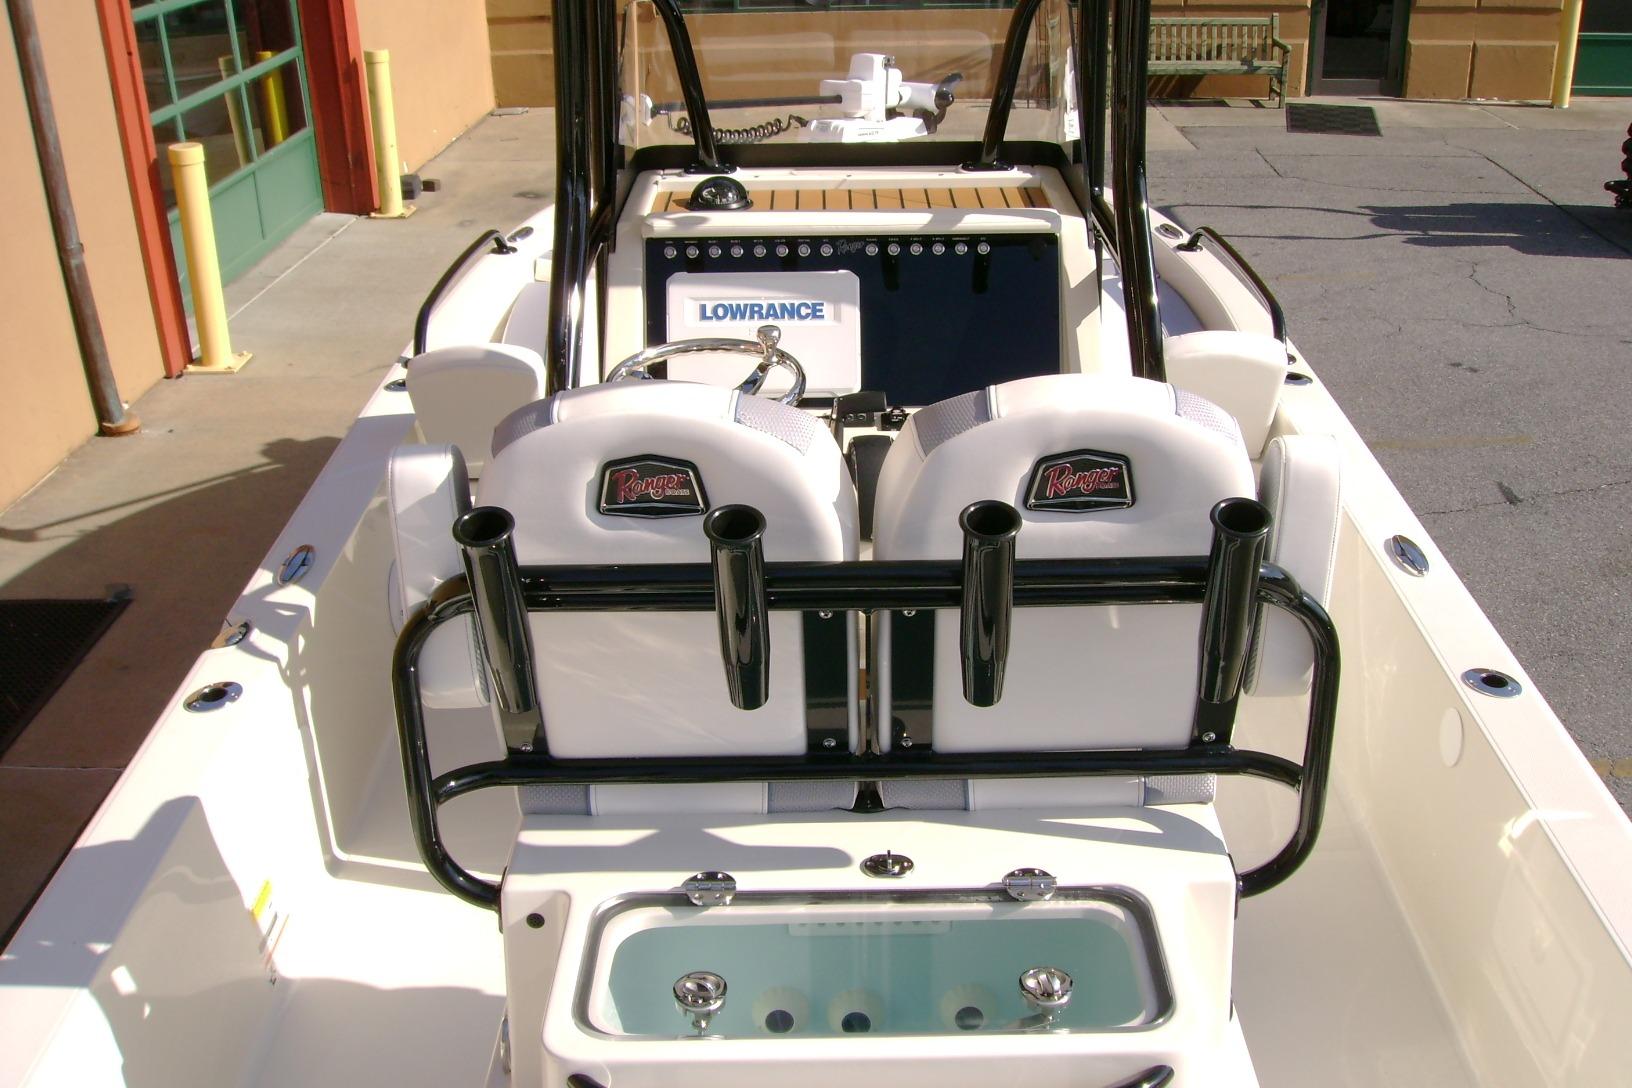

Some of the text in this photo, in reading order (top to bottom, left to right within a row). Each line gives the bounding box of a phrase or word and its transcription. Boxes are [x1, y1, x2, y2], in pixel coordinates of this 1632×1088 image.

[699, 302, 825, 321] LOWRANCE
[612, 468, 689, 503] Ranger
[1044, 463, 1120, 498] Ranger
